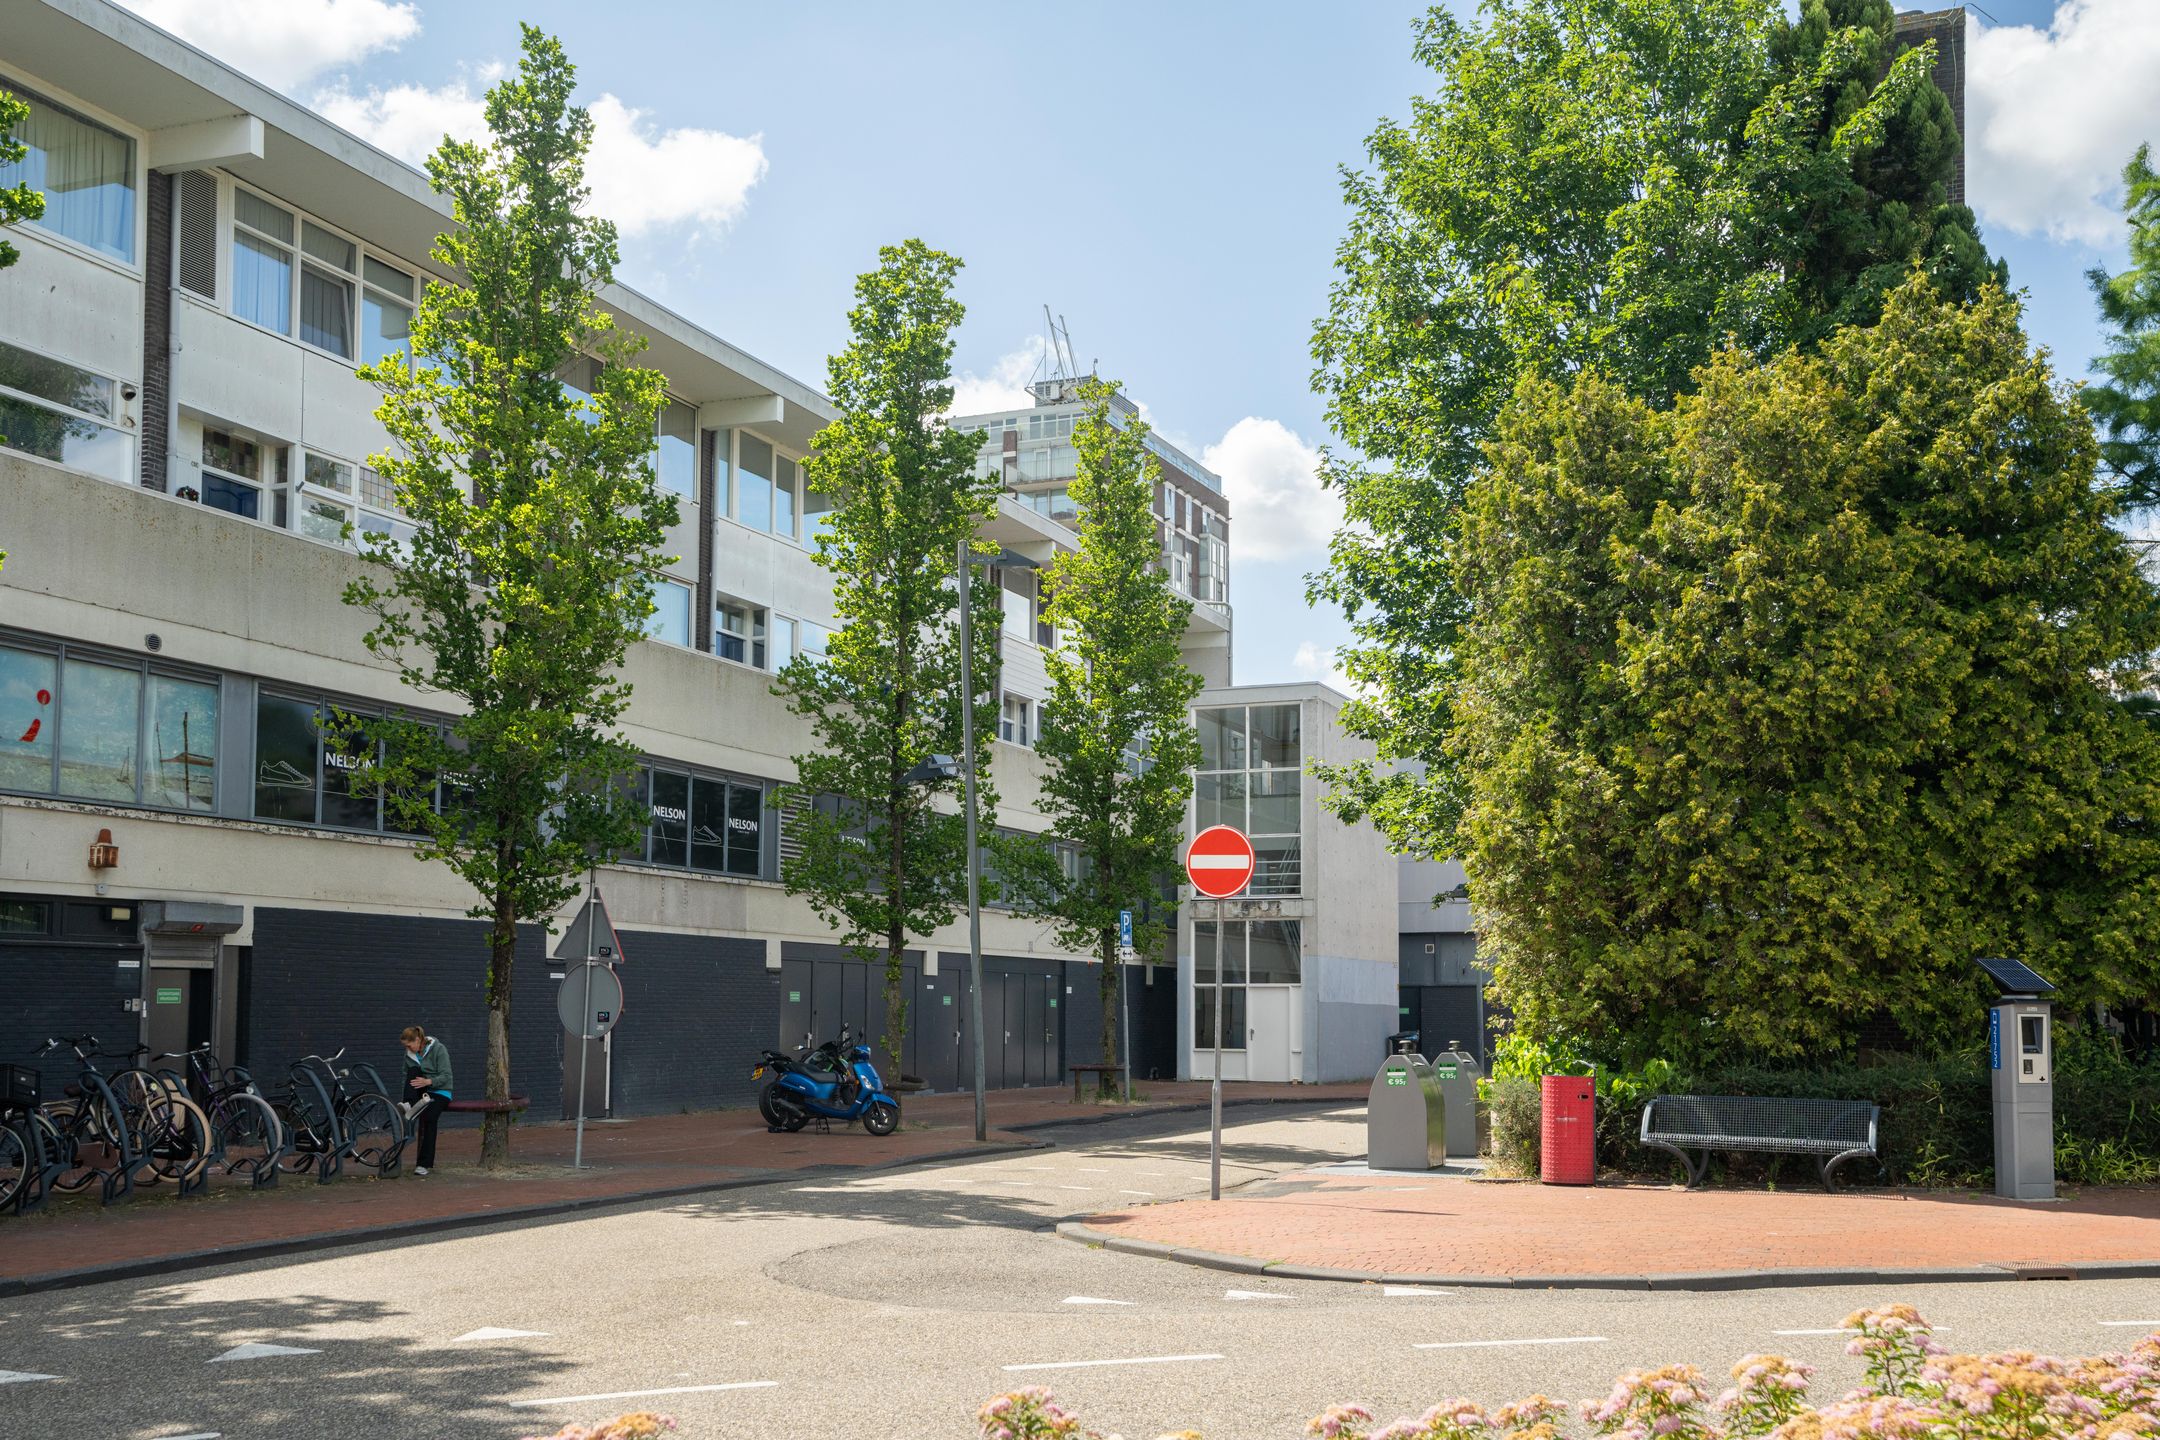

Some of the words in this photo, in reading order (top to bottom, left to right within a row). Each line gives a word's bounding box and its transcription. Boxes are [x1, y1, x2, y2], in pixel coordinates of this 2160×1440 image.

[653, 805, 686, 820] NELSON
[728, 817, 758, 832] NELSON
[1123, 914, 1130, 932] P
